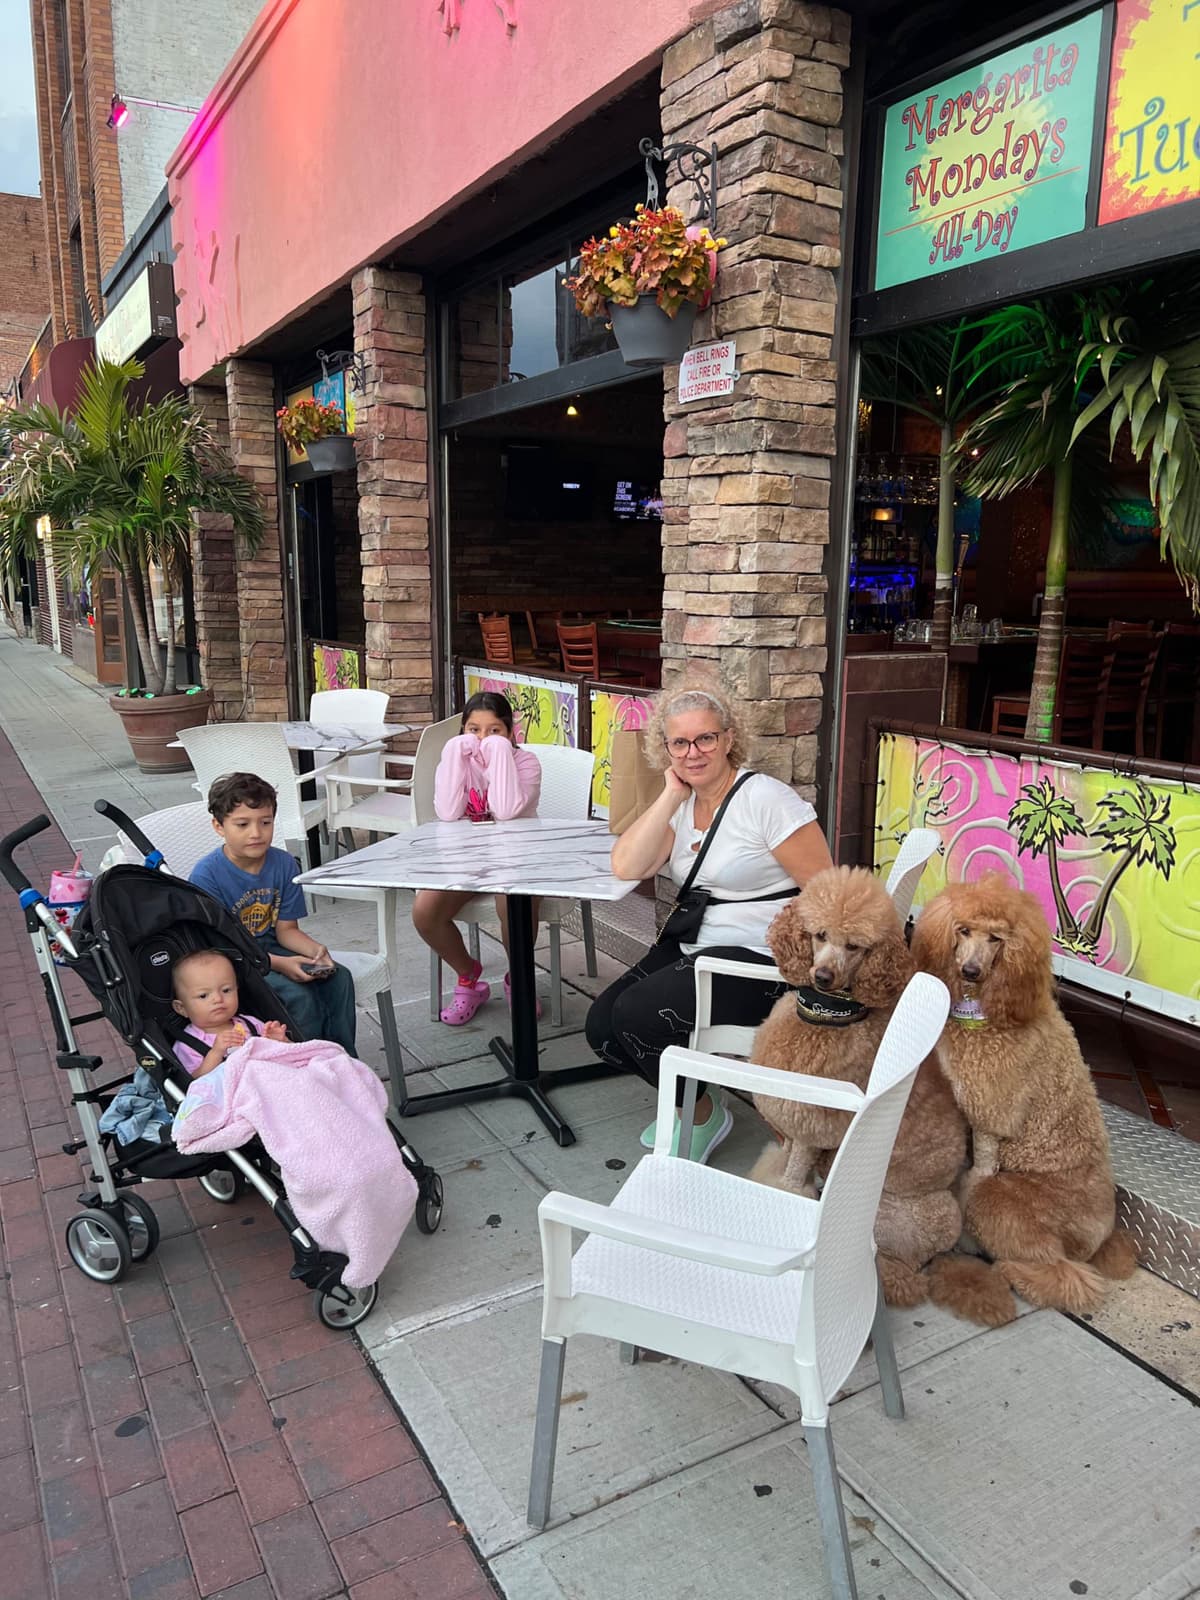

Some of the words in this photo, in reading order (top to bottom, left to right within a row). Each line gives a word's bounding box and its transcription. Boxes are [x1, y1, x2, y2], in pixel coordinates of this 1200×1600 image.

[902, 42, 1079, 151] Margarita
[929, 206, 1018, 265] All-Day
[696, 350, 709, 363] BELL
[711, 346, 729, 359] RINGS
[699, 365, 711, 378] FIRE
[712, 363, 721, 376] OR
[694, 378, 731, 395] DEPARTMENT
